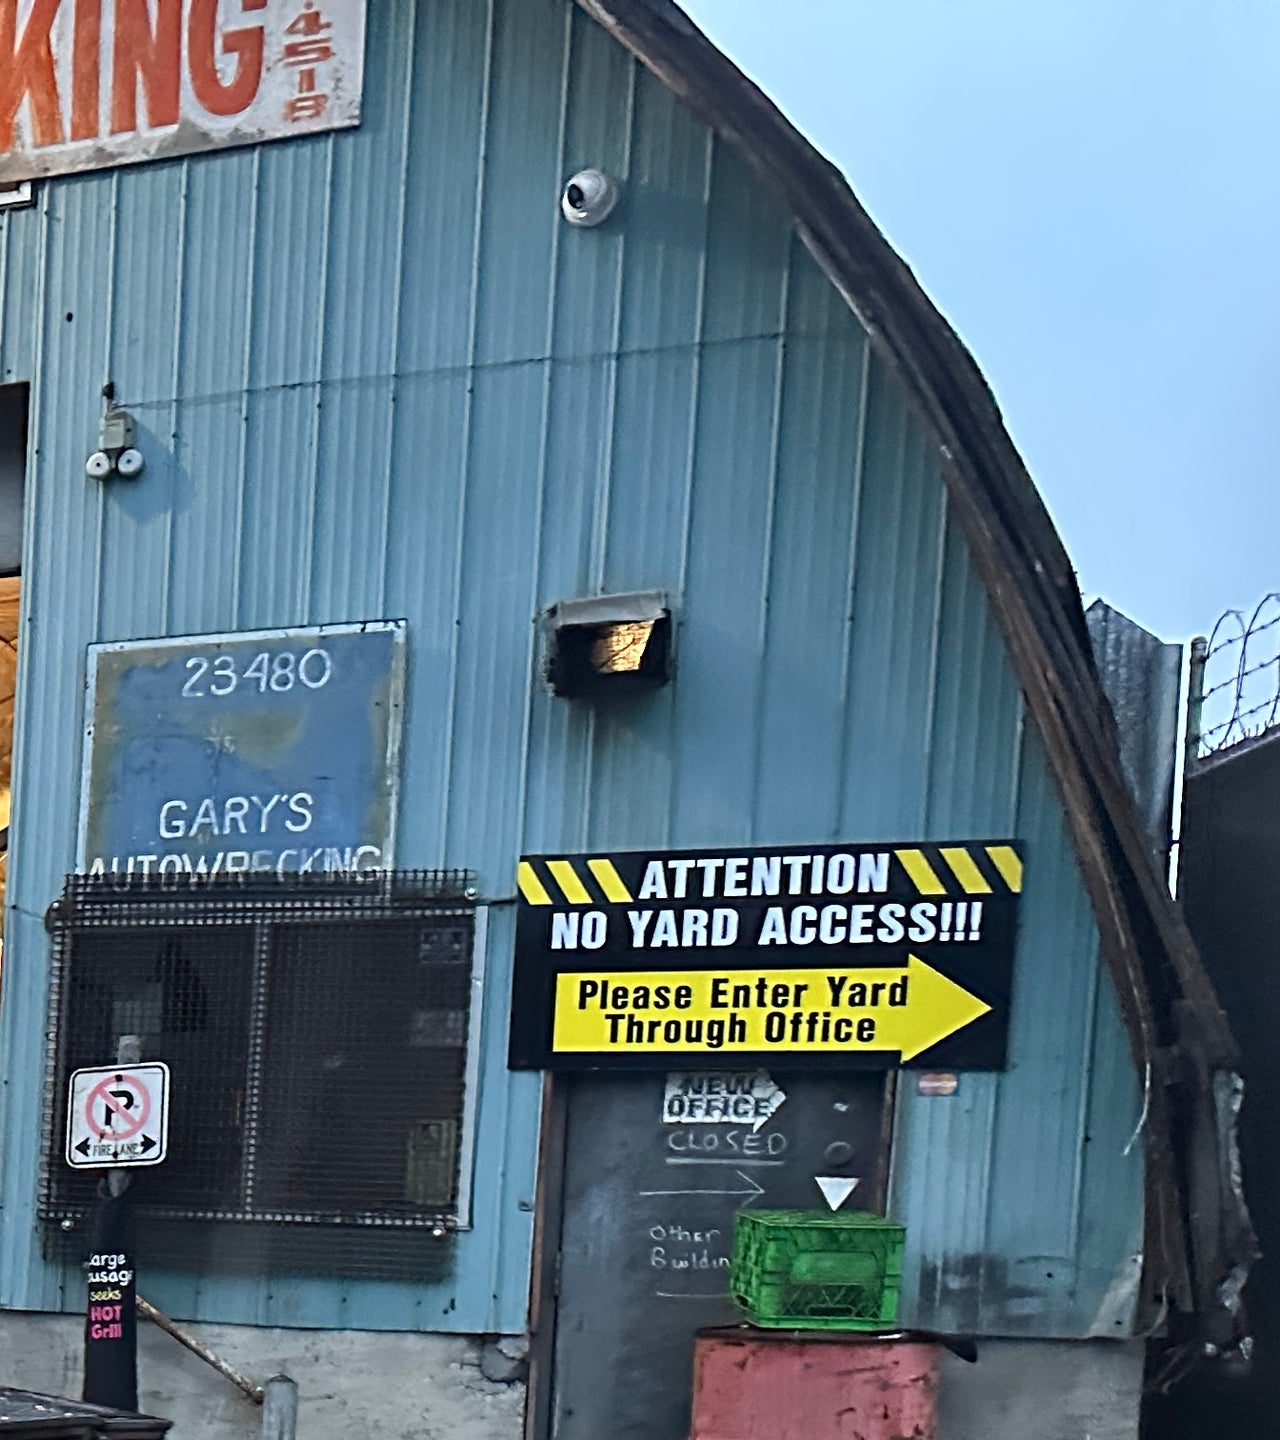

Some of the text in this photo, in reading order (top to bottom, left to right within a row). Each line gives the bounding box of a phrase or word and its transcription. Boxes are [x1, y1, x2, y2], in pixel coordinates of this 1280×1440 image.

[182, 648, 333, 698] 23480
[159, 792, 314, 839] GARY'S
[638, 853, 890, 899] ATTENTION
[551, 901, 984, 950] NO YARD ACCESS!!!
[578, 975, 909, 1010] Please Enter Yard
[605, 1011, 877, 1049] Through Office
[667, 1094, 771, 1118] OFFICE
[668, 1131, 787, 1155] CLOSED
[650, 1225, 721, 1242] Other
[89, 1253, 126, 1270] arge
[651, 1246, 731, 1269] Buildin
[91, 1305, 123, 1321] HOT
[91, 1323, 123, 1339] Grill
